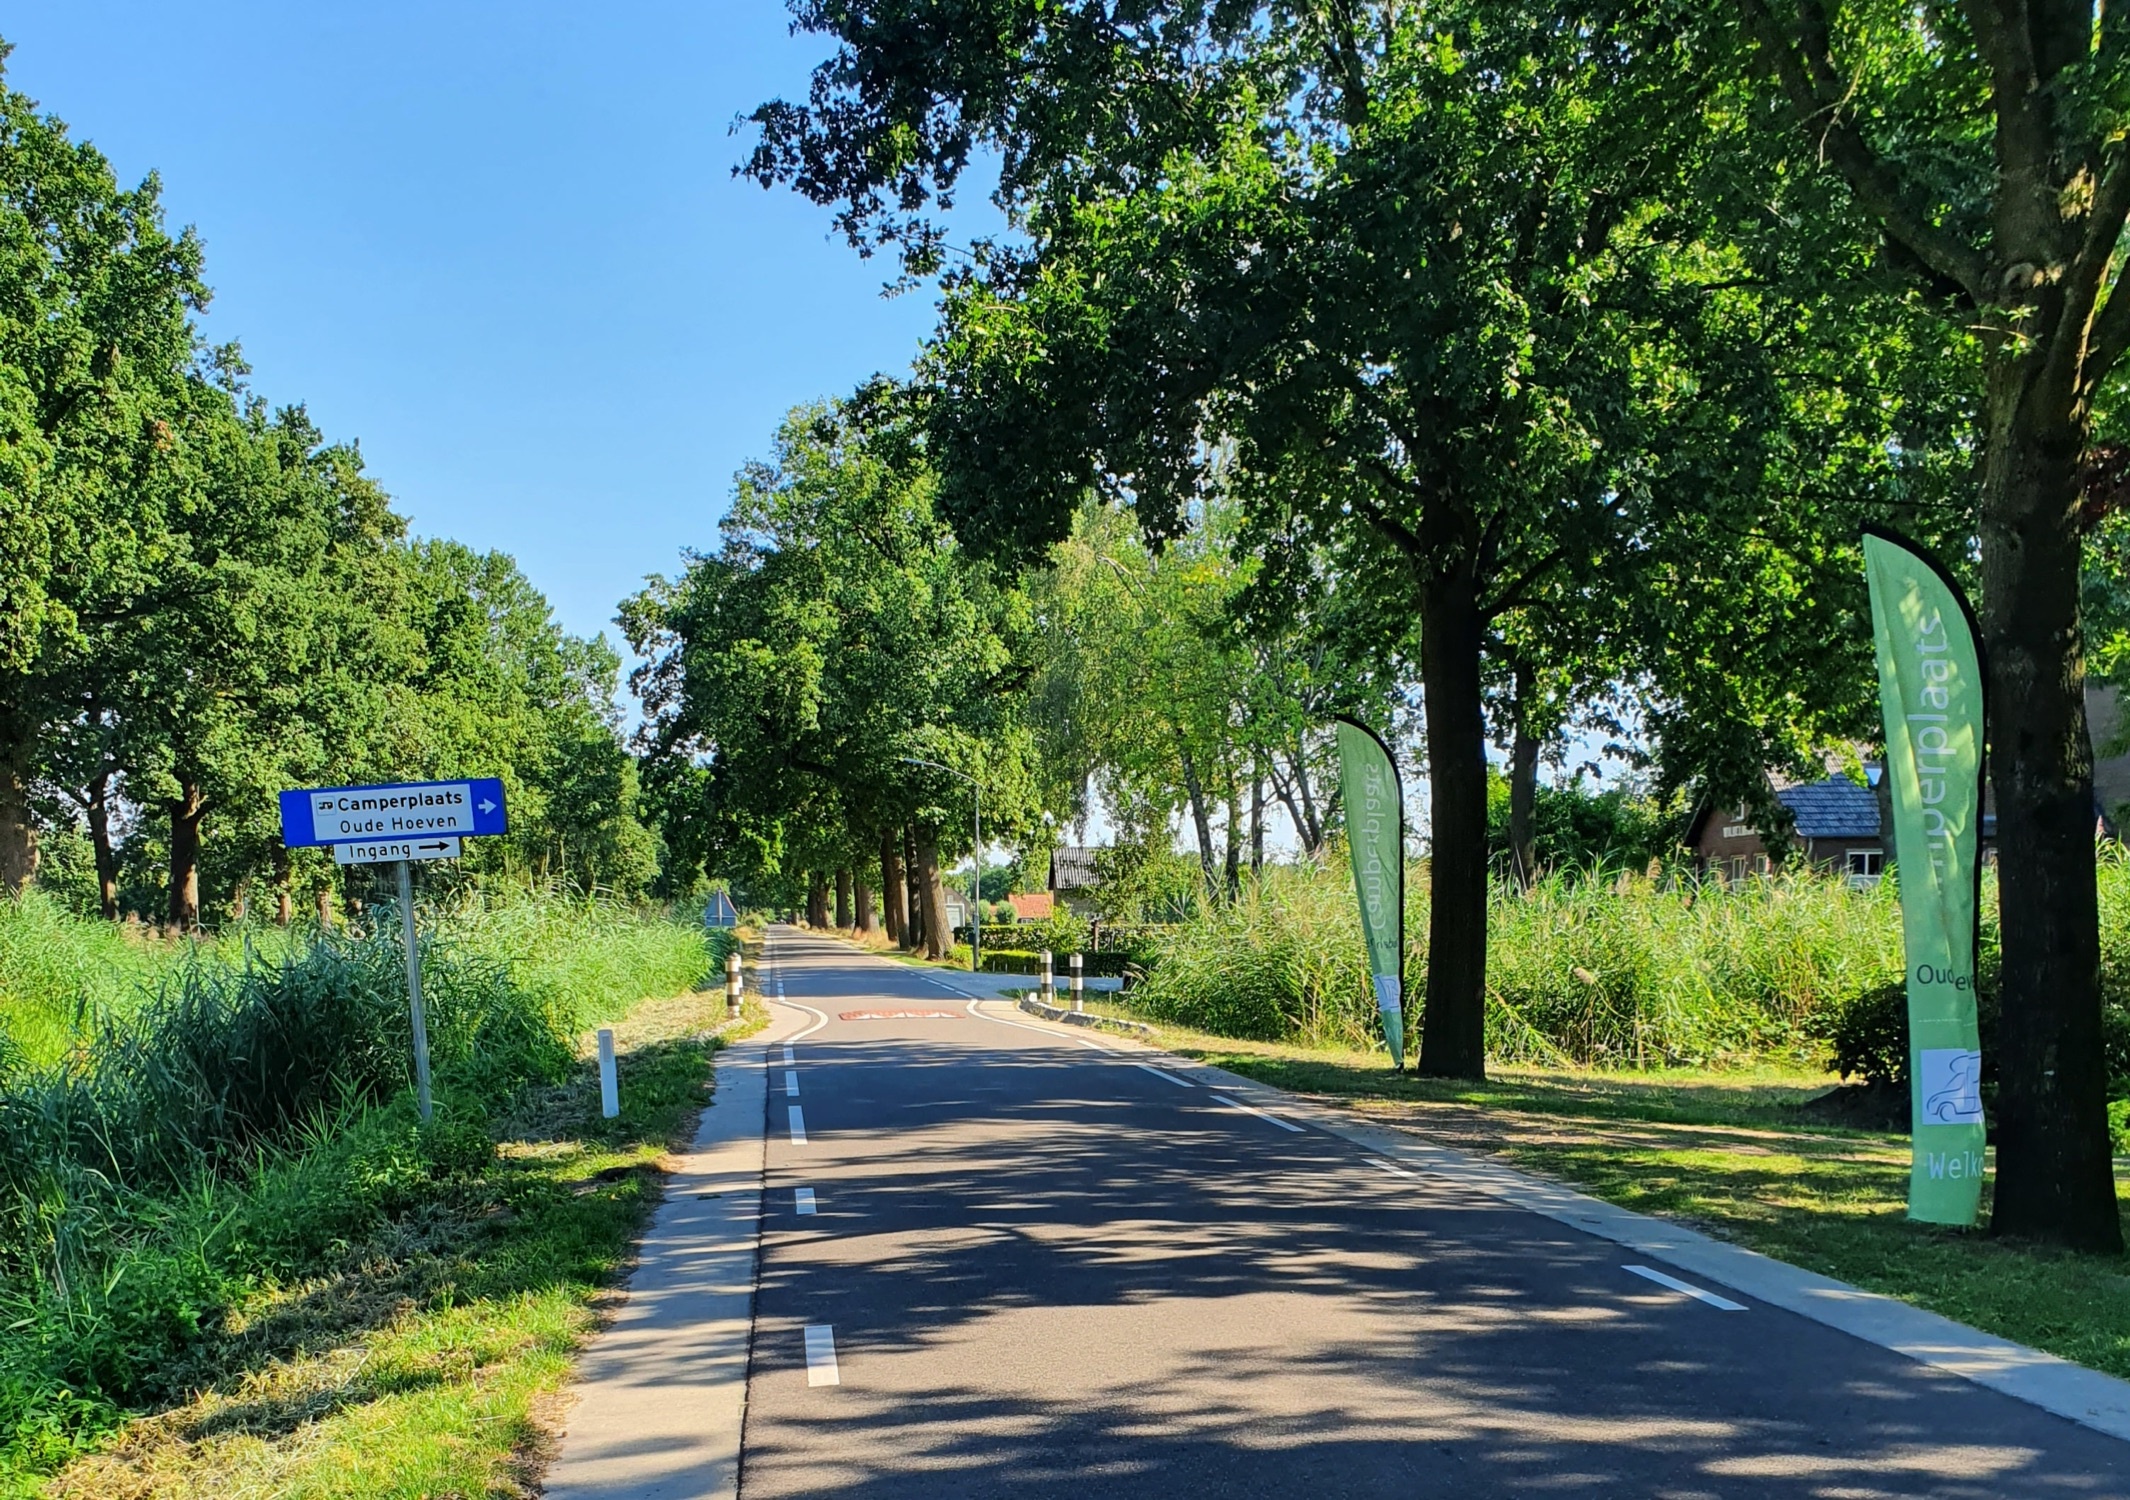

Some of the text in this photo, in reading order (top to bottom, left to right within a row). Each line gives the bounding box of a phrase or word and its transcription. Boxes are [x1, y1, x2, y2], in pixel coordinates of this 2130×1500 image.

[337, 791, 463, 813] Camperplaats
[340, 815, 457, 834] Oude Hoeven
[349, 844, 411, 861] Ingang
